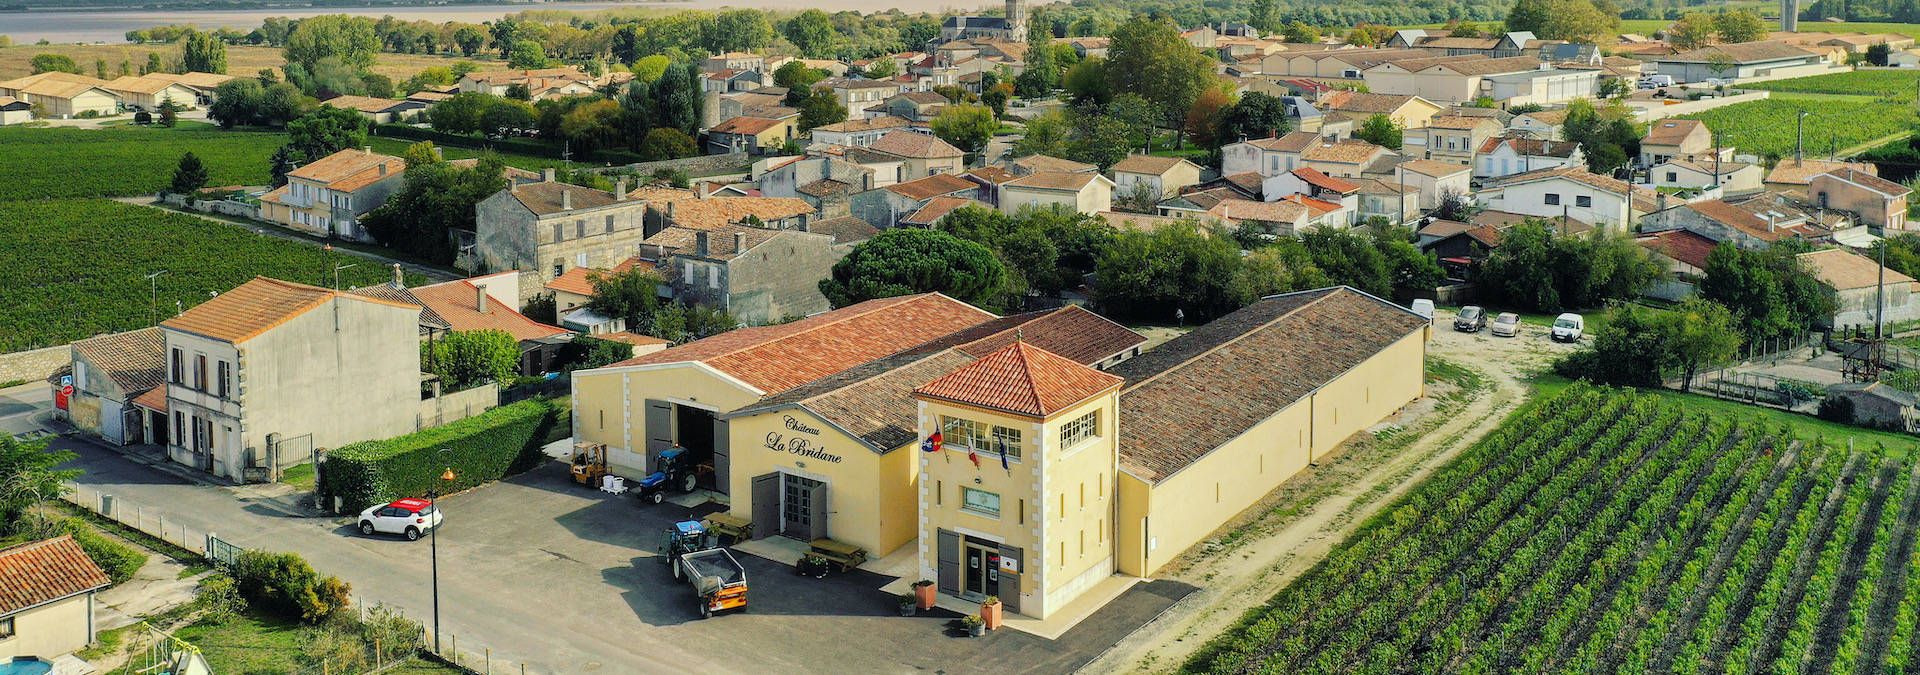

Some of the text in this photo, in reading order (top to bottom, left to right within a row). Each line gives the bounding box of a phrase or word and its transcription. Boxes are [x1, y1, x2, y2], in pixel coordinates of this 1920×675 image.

[783, 415, 820, 436] Château
[764, 431, 842, 464] La Bridane
